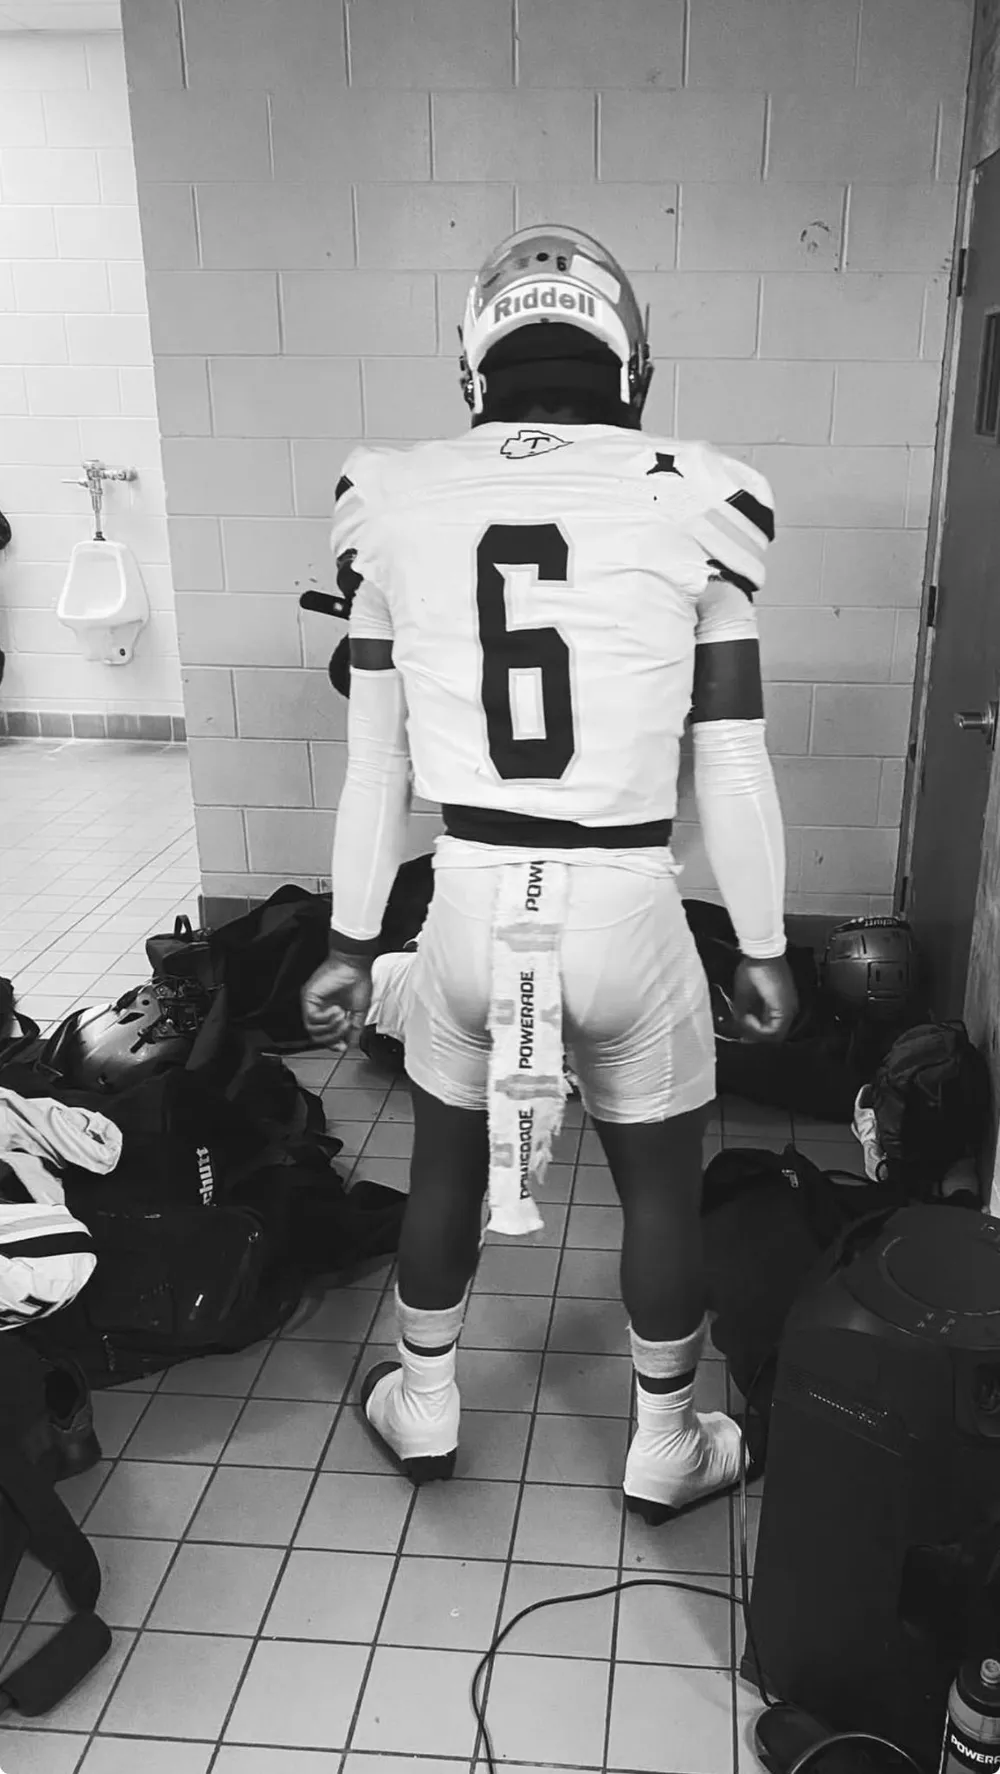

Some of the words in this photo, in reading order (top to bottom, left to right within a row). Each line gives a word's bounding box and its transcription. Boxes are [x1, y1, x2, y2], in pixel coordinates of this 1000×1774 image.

[556, 255, 568, 272] 6
[494, 287, 596, 324] Riddell
[522, 436, 551, 450] T
[475, 521, 577, 781] 6
[518, 970, 534, 1069] POWERADE
[196, 1146, 214, 1205] chutt
